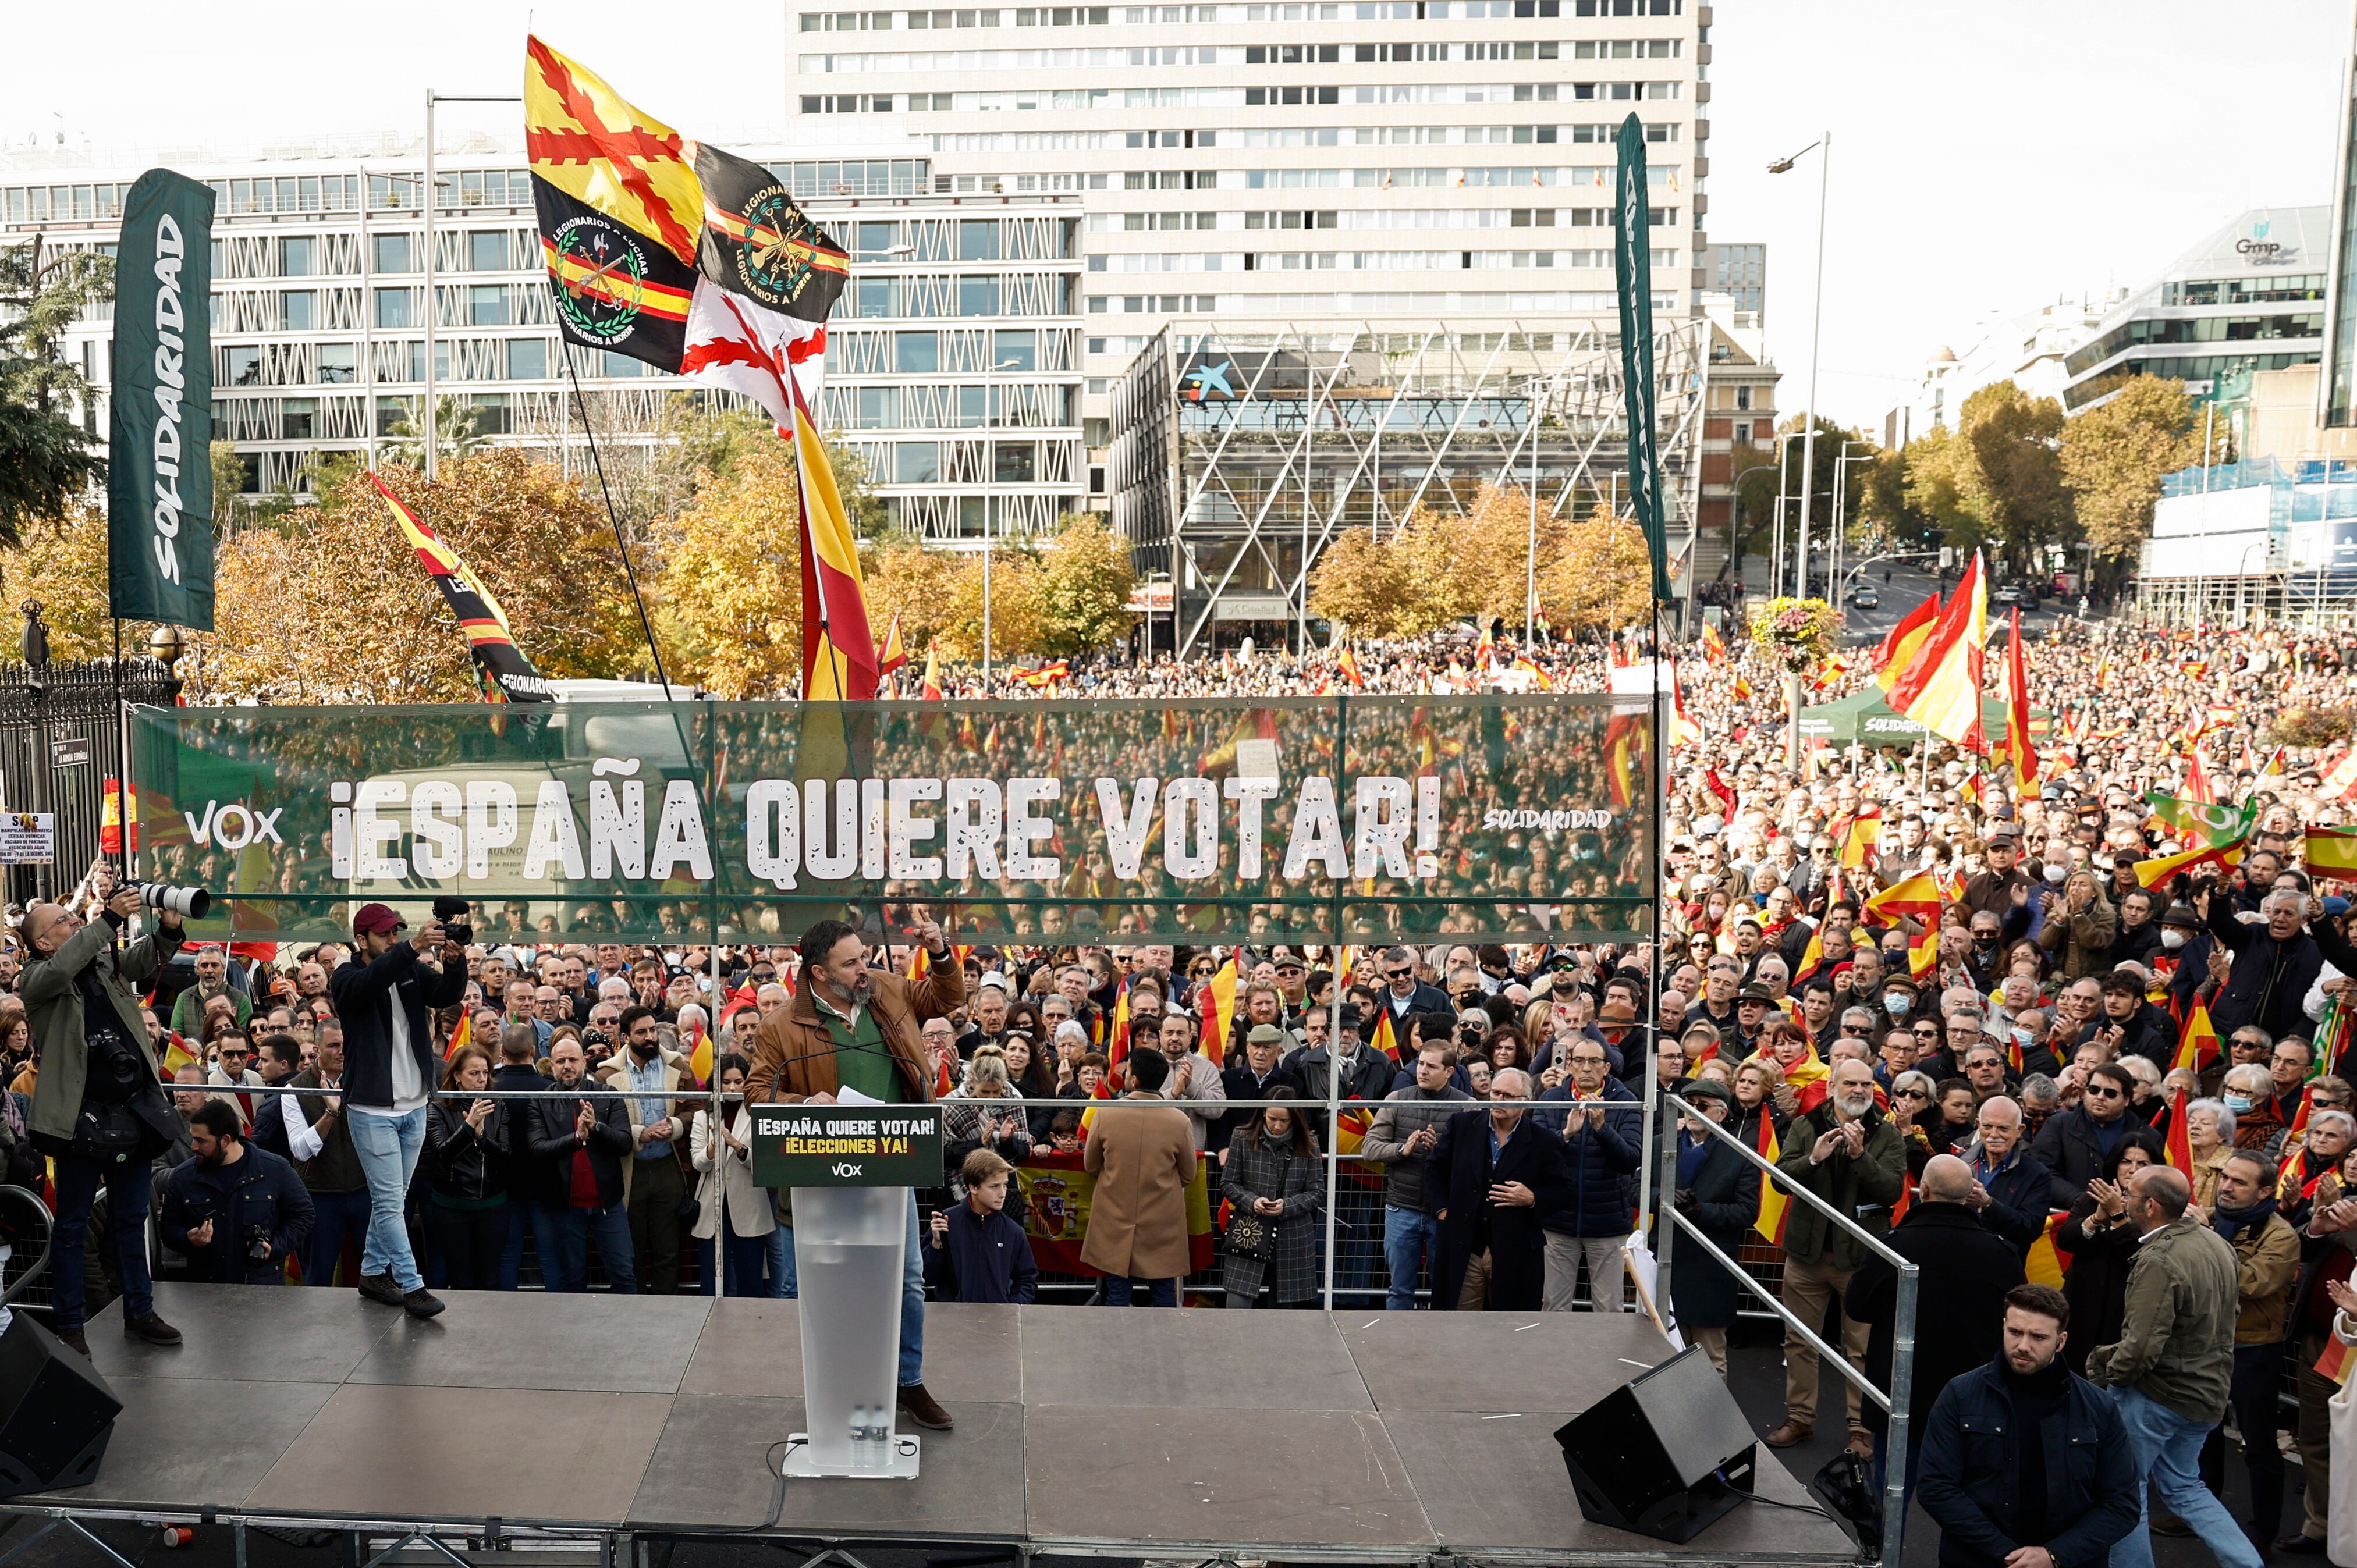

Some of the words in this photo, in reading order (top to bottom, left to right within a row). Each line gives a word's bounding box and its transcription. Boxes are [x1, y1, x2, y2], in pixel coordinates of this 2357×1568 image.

[553, 216, 610, 241] LEGIONARIOS
[2236, 239, 2280, 256] Gmp
[736, 249, 779, 304] LEGIONARIOS
[782, 295, 790, 304] A
[792, 271, 812, 302] MORIR
[553, 296, 603, 345] LEGIONARIOS
[612, 324, 636, 344] MORIR
[154, 213, 185, 586] SOLIDARIDAD
[500, 674, 552, 695] EGIONARI
[12, 816, 38, 826] SP
[184, 799, 283, 849] VOX
[331, 757, 715, 880] ¡ESPAÑA
[747, 778, 1061, 891] QUIERE
[1095, 776, 1441, 880] VOTAR!
[1482, 809, 1613, 831] SOLIDARIDAD
[826, 1119, 876, 1136] QUIERE
[881, 1118, 935, 1135] VOTAR!
[832, 1162, 862, 1178] VOX
